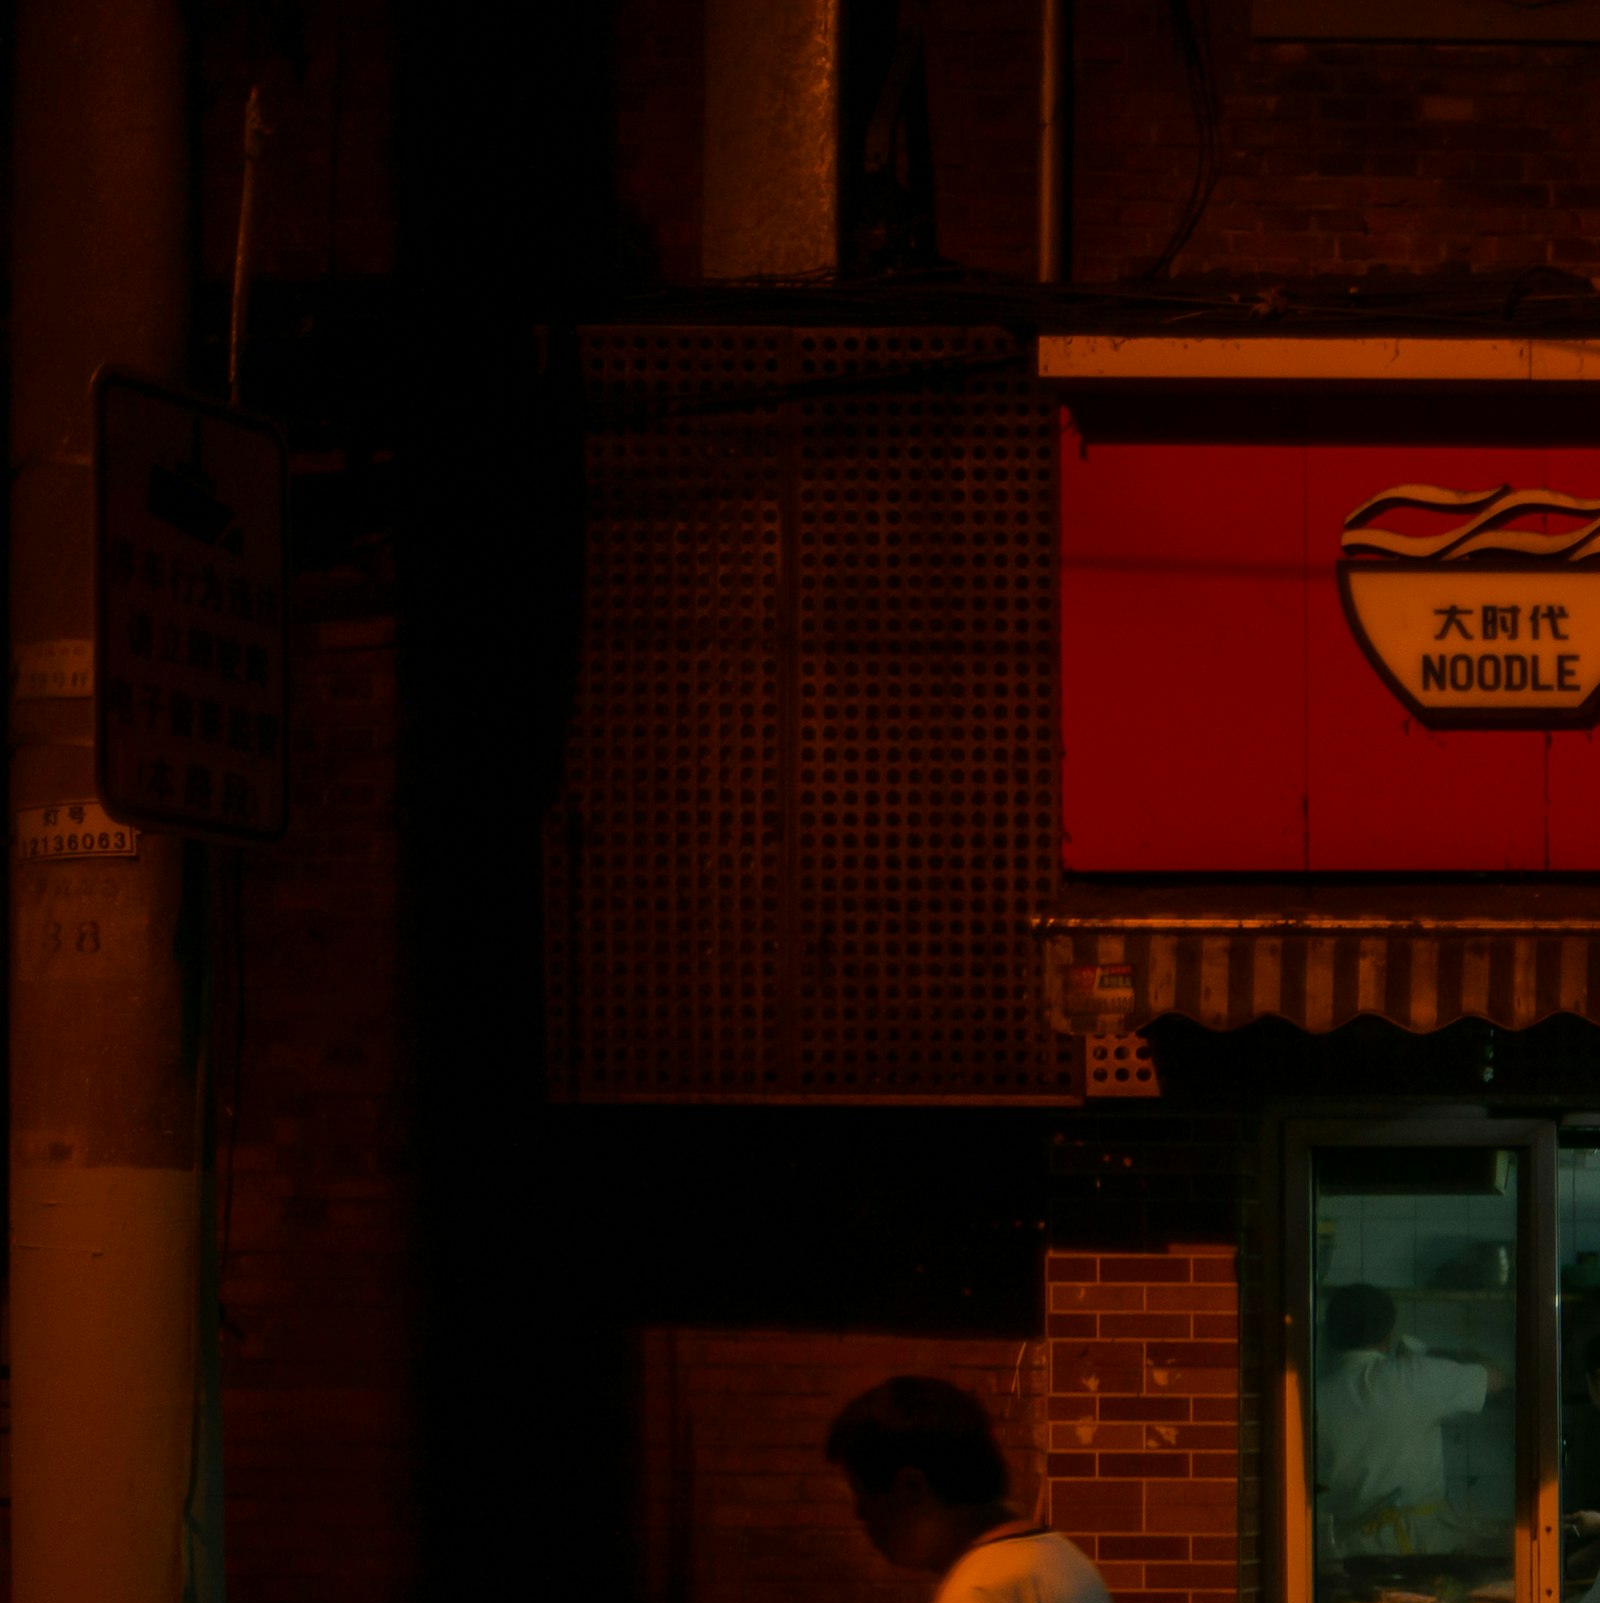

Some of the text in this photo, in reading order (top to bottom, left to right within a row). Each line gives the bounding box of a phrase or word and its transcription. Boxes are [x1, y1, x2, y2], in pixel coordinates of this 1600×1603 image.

[1433, 604, 1570, 641] 大时代
[1421, 654, 1581, 693] NOODLE
[21, 831, 126, 857] 12136063
